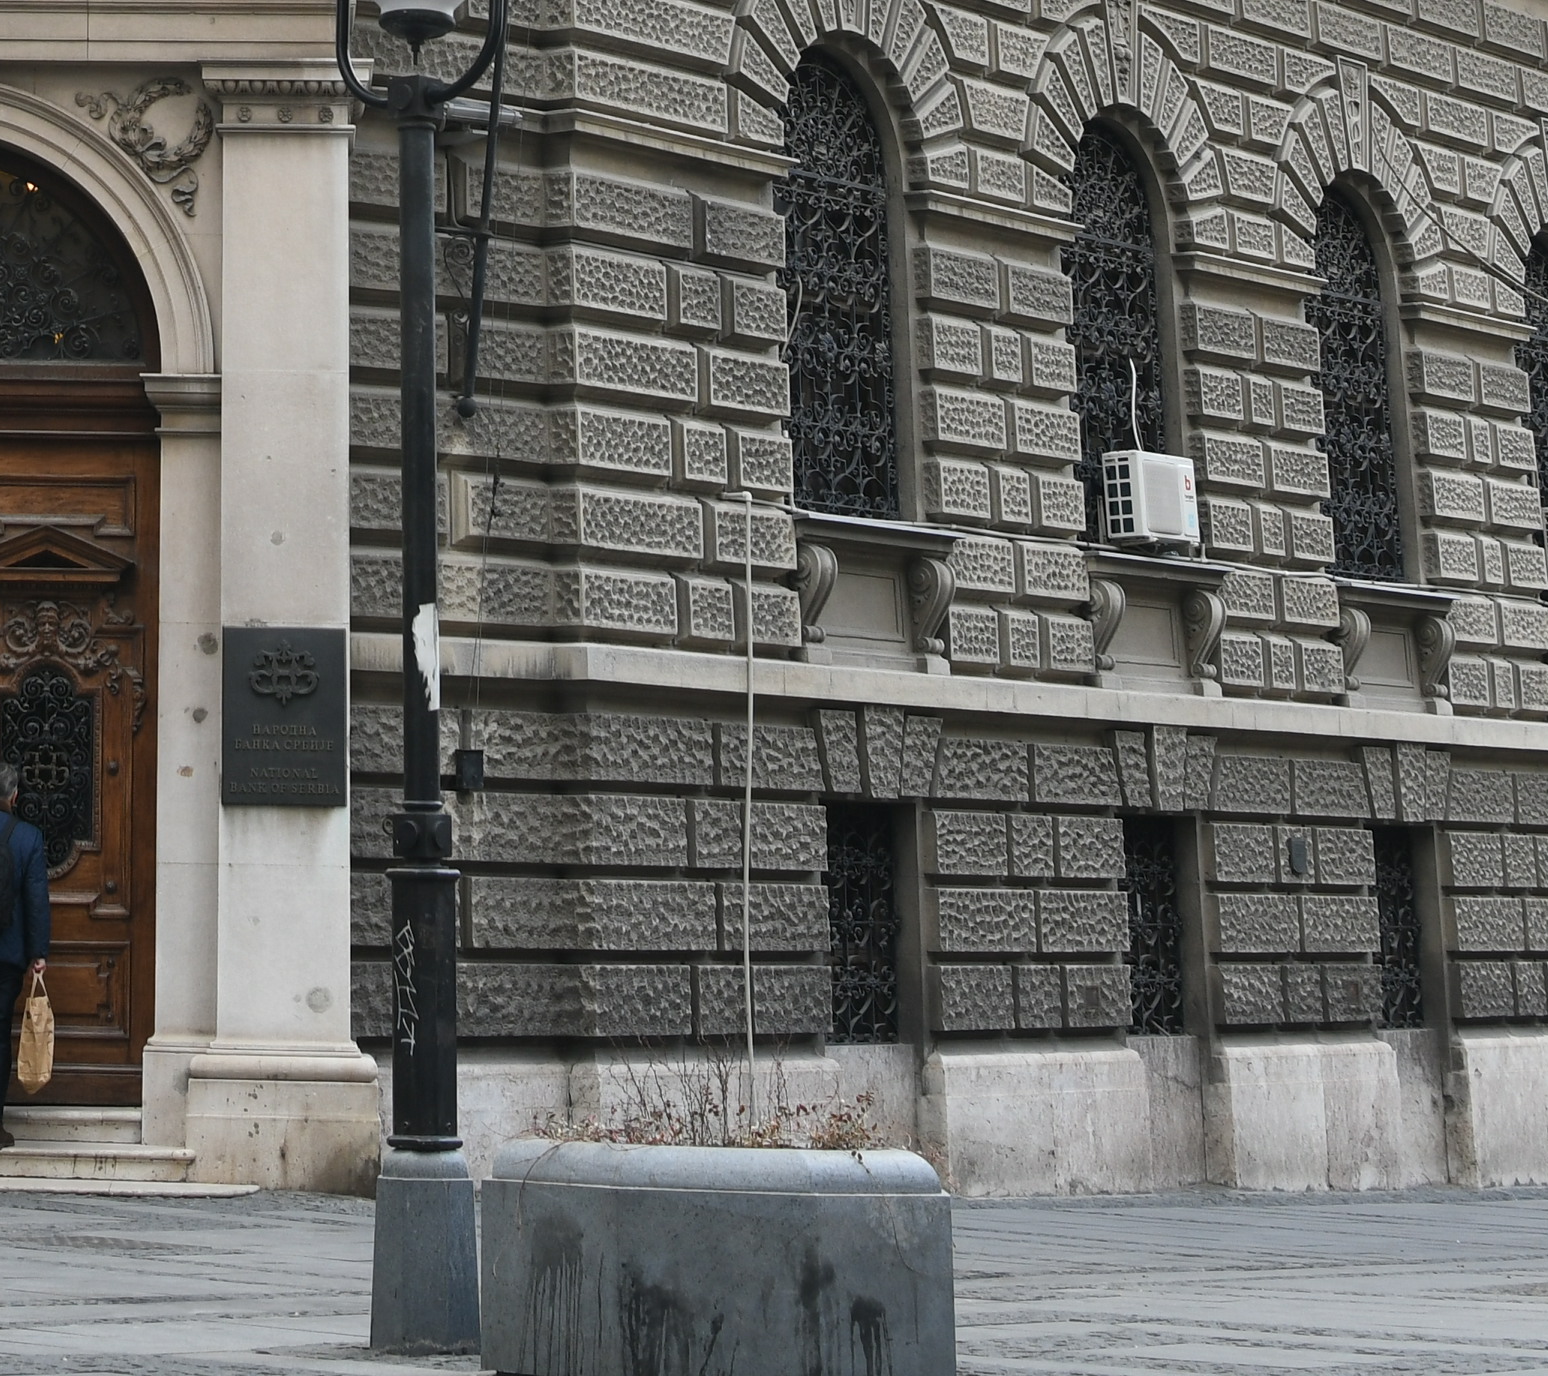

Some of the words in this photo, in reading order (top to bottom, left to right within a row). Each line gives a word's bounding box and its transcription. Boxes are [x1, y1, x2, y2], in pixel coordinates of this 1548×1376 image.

[234, 739, 281, 750] БАНКА
[250, 768, 319, 779] NATIONAL
[230, 782, 267, 793] BANK
[271, 783, 286, 793] OF
[291, 783, 340, 794] SERBIA
